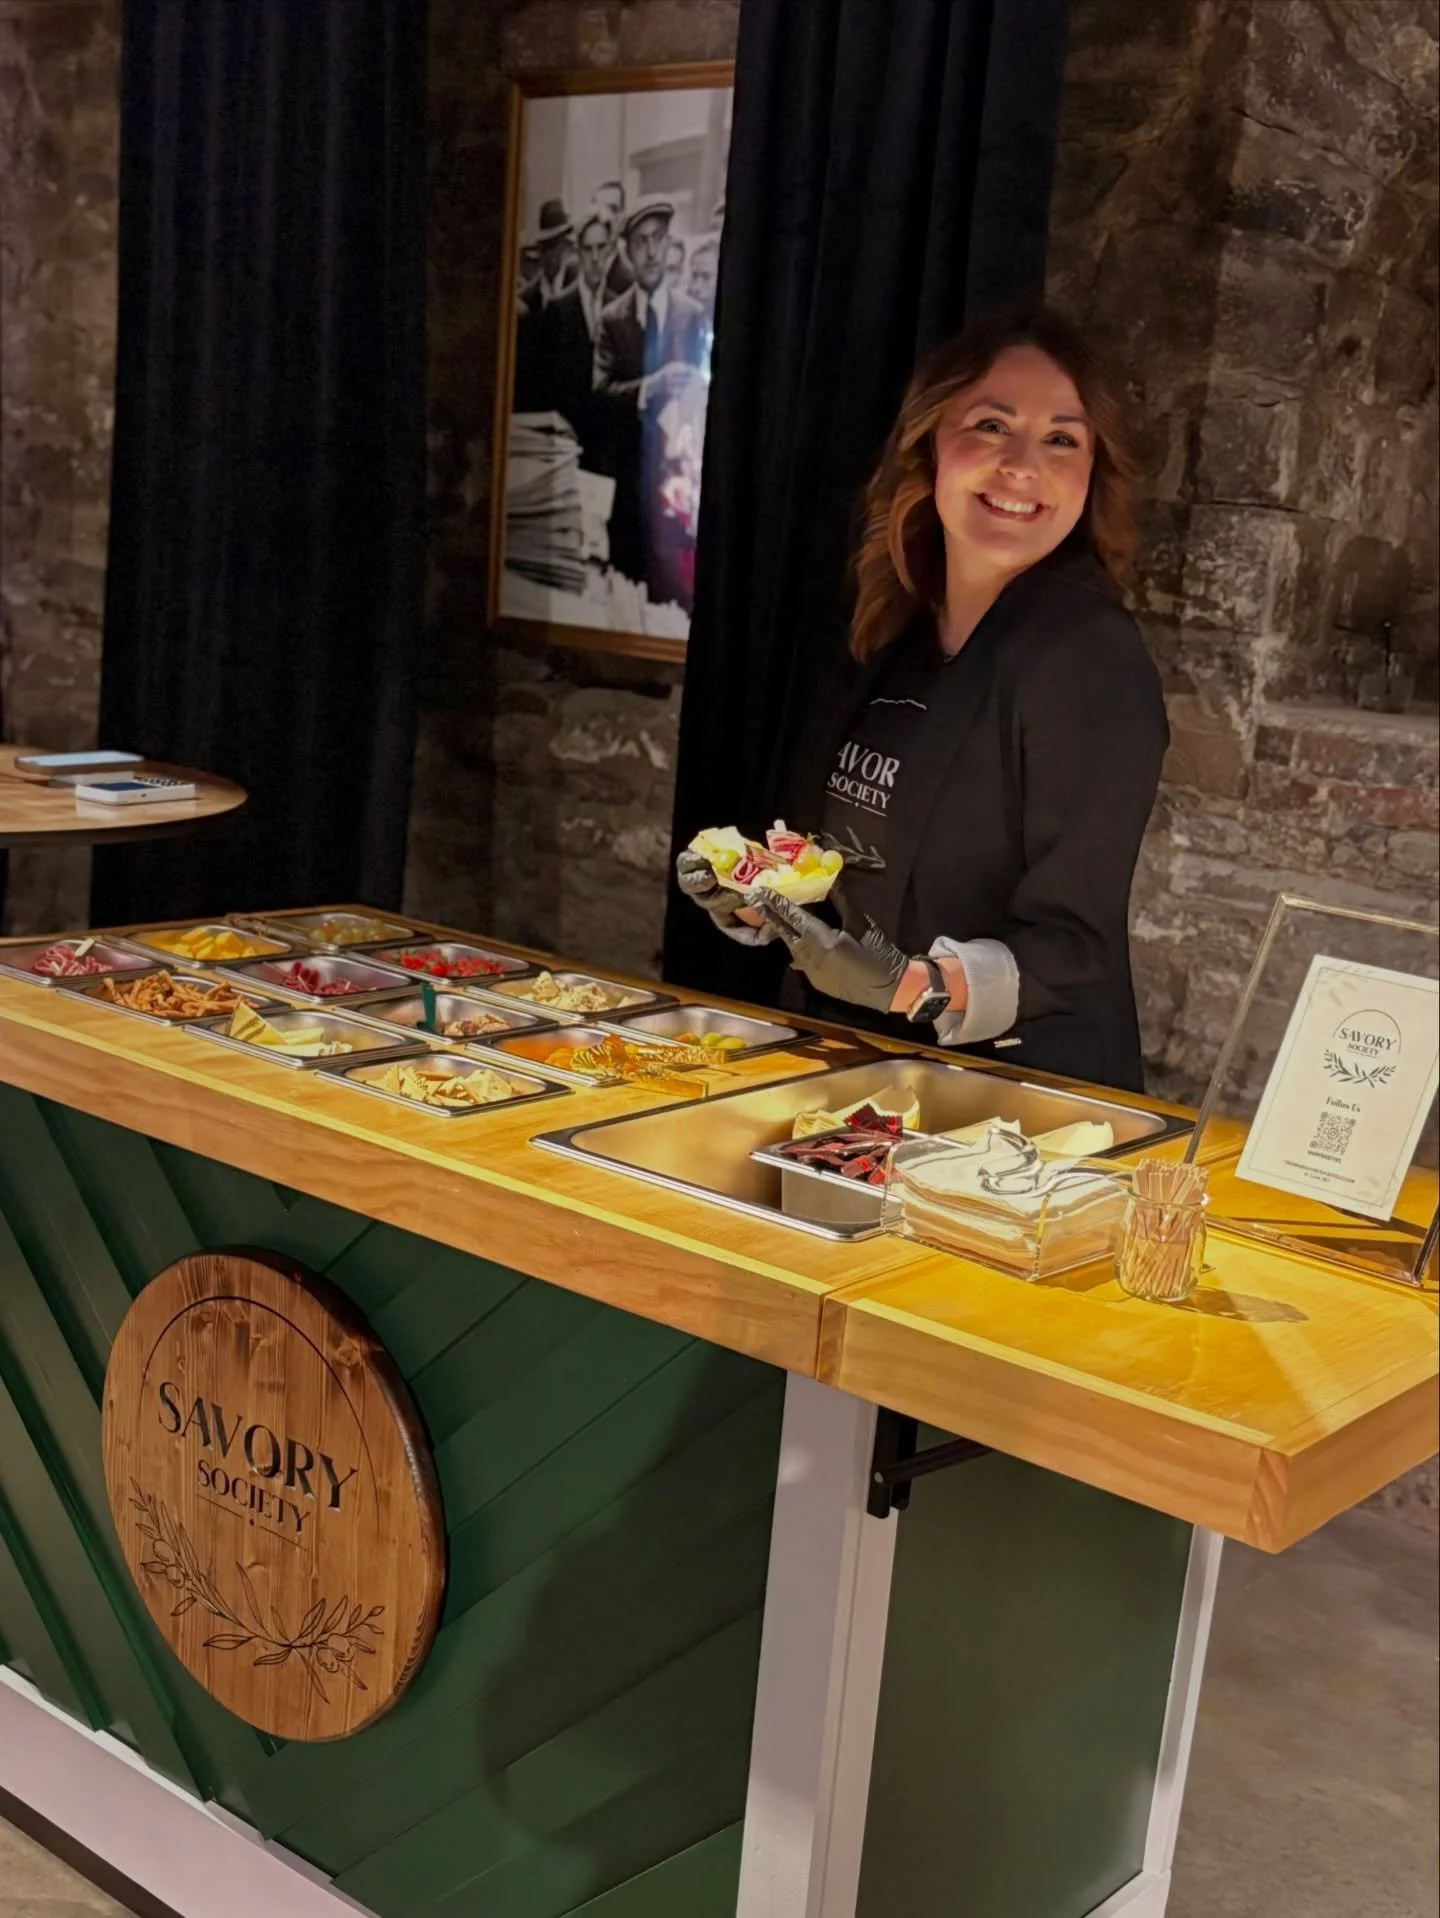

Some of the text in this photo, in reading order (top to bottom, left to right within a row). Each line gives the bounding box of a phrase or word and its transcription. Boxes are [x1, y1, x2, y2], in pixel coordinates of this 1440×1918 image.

[838, 741, 900, 788] AVOR
[827, 772, 891, 809] SOCIETY
[1338, 1027, 1397, 1051] SAVORY
[1326, 1096, 1361, 1113] Follow Us
[158, 1382, 358, 1512] SAVORY
[197, 1458, 311, 1533] SOCIETY
